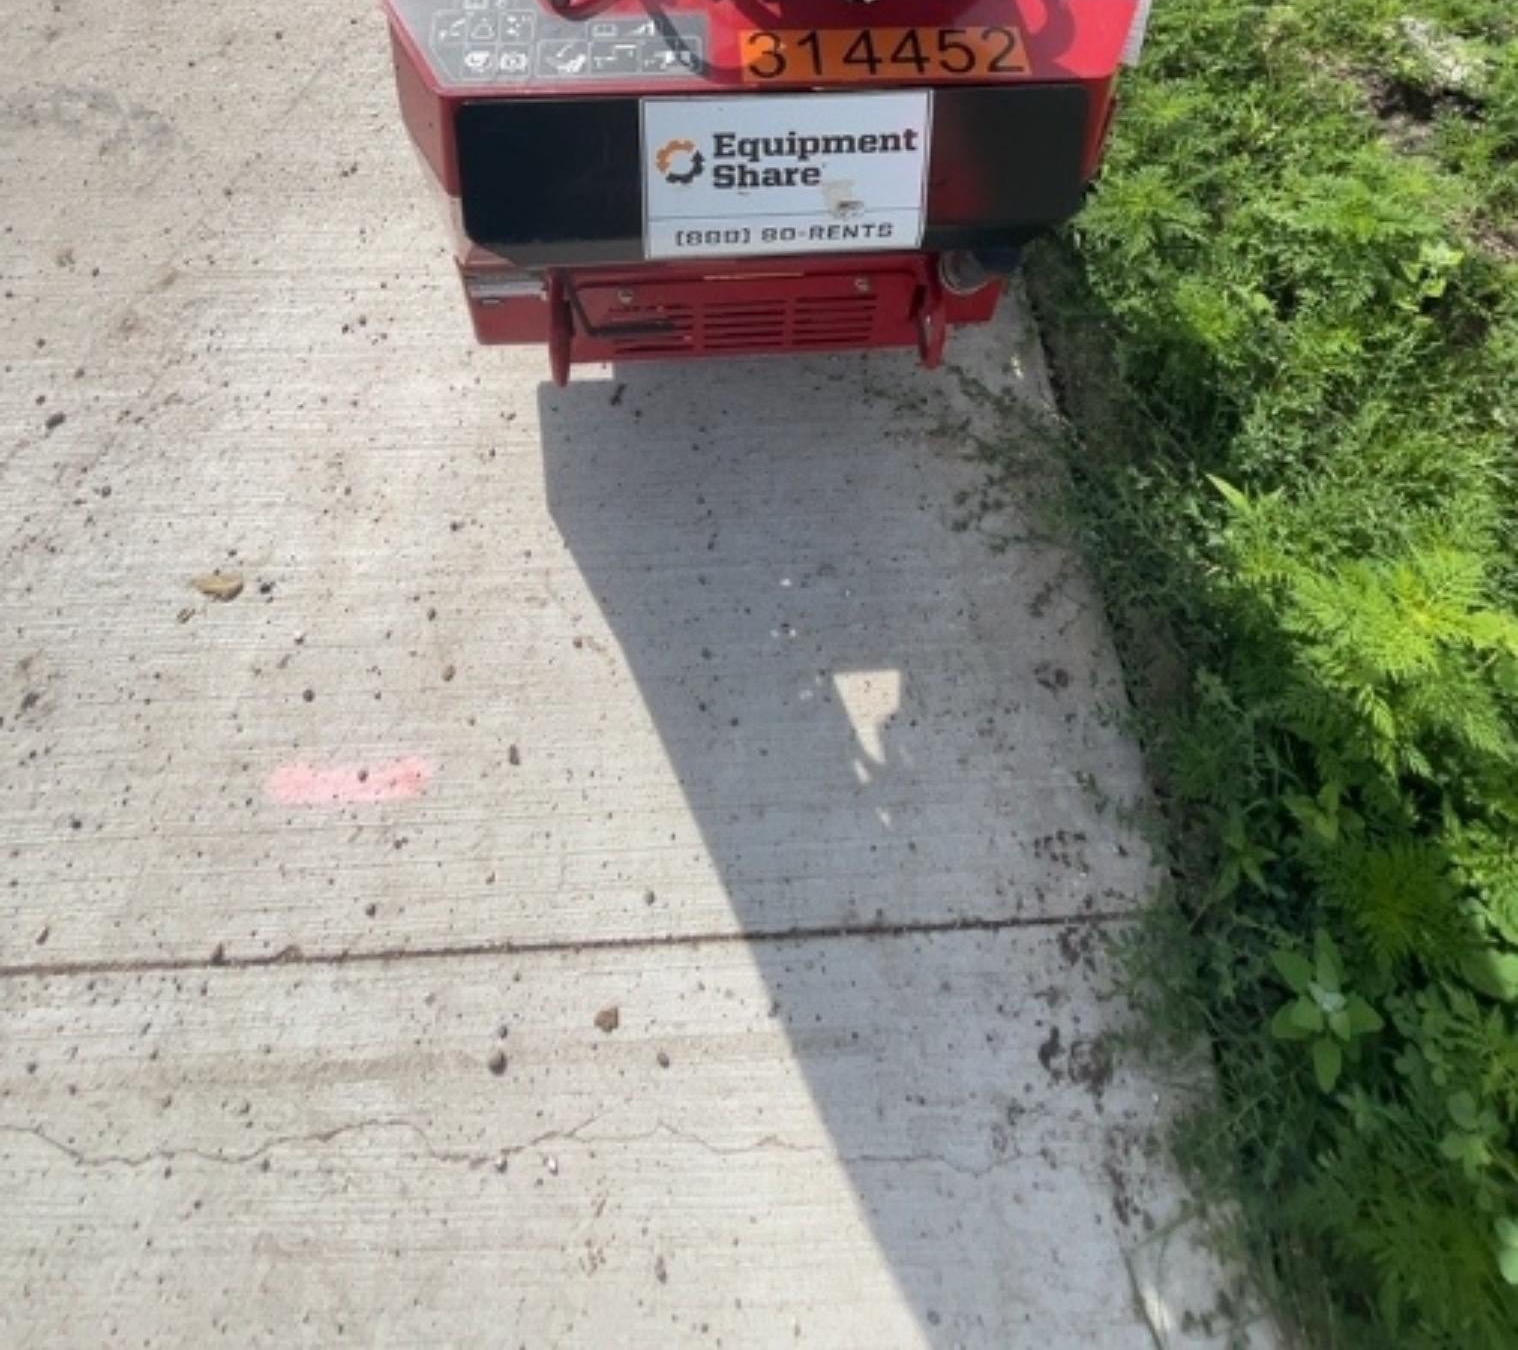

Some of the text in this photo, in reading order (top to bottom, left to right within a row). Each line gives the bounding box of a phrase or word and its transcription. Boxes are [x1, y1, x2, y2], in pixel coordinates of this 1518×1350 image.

[748, 26, 1025, 79] 314452
[712, 128, 919, 162] Equipment
[713, 164, 822, 189] Share
[761, 222, 894, 243] 80-RENTS
